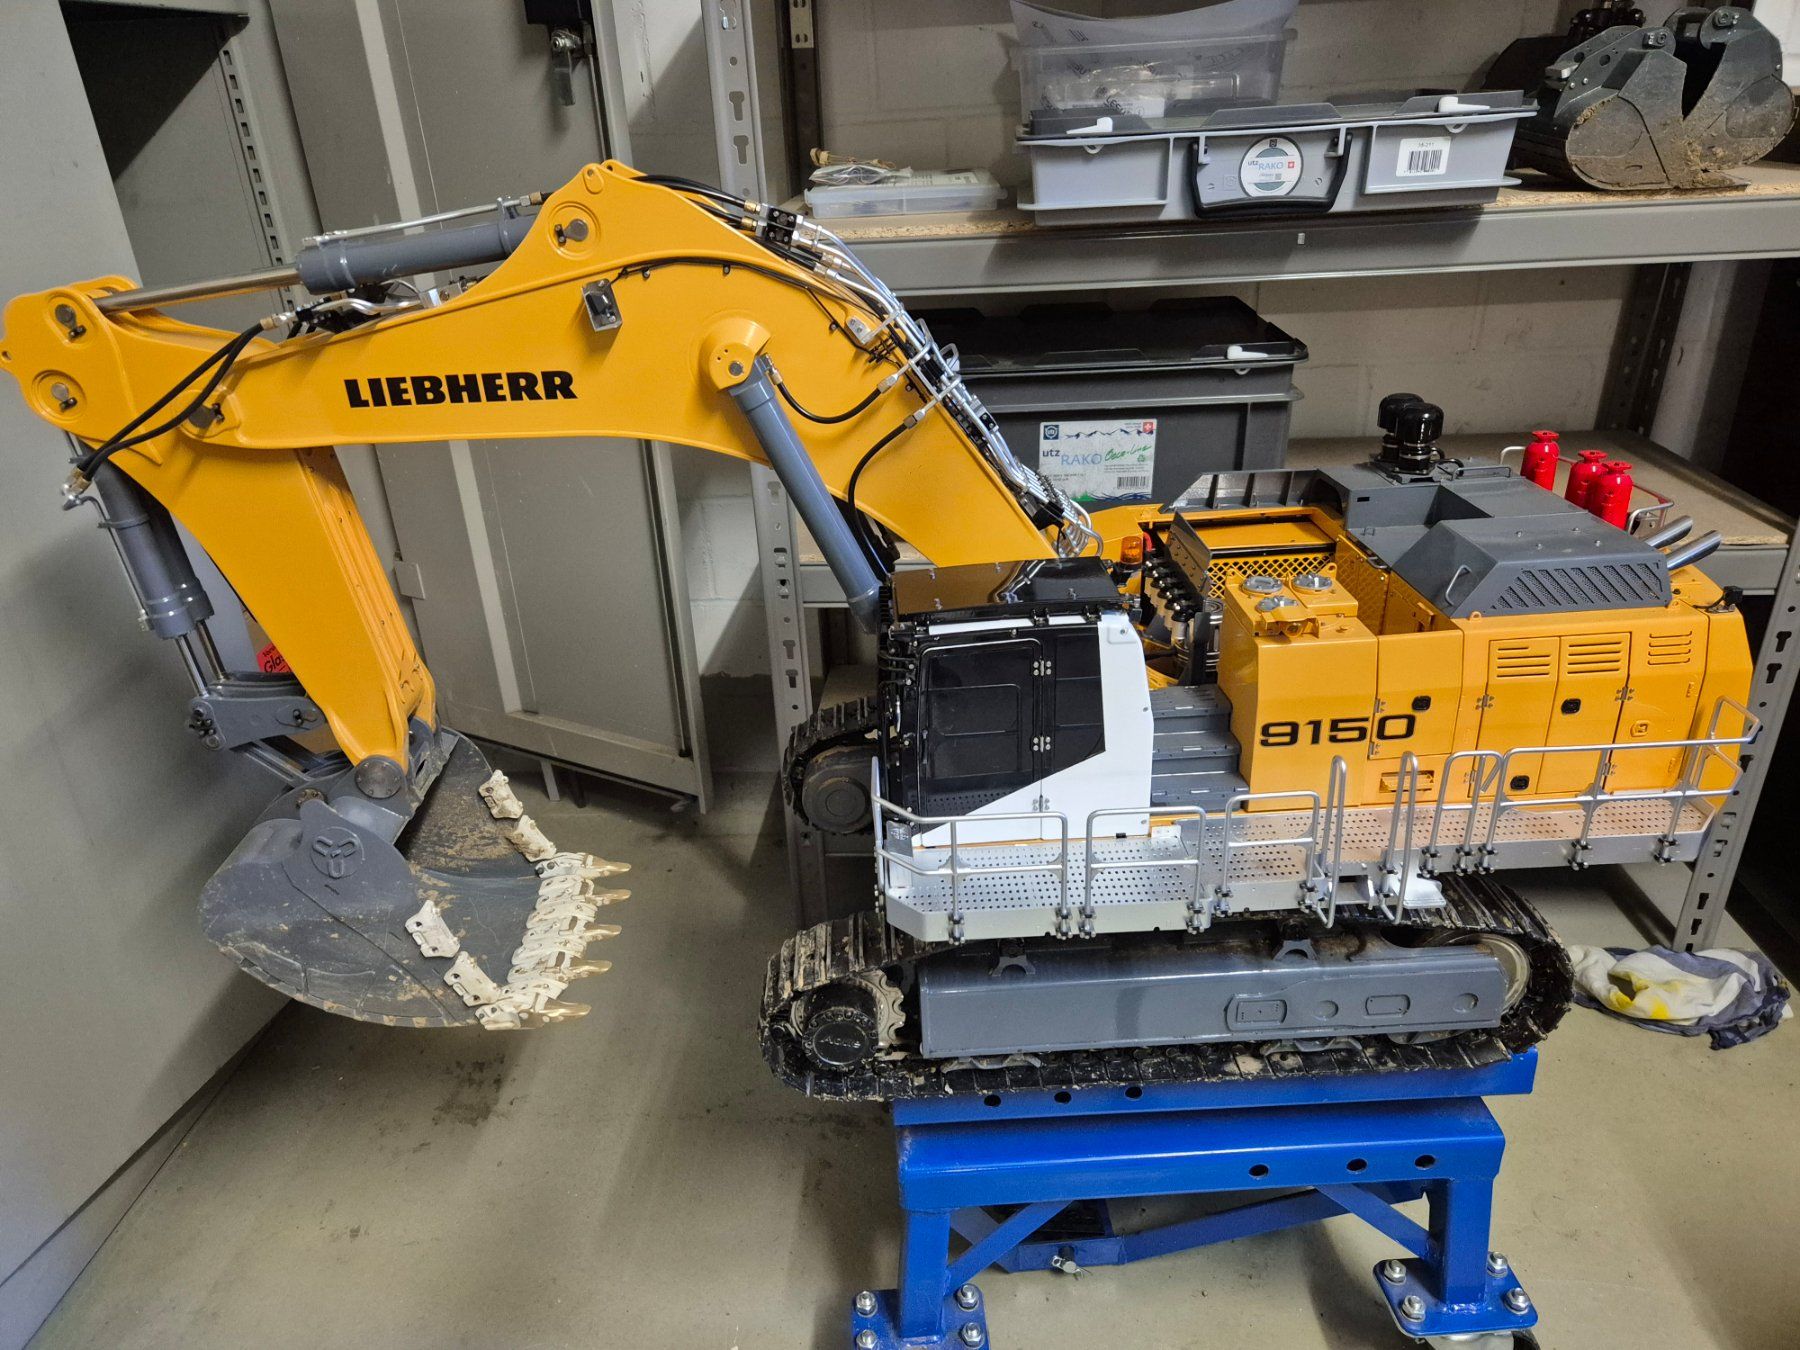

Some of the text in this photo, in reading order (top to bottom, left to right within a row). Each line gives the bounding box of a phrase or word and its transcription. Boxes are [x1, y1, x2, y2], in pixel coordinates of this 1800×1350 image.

[1258, 162, 1284, 170] RAKO
[344, 371, 578, 408] LIEBHERR
[1043, 449, 1060, 457] utz
[1061, 454, 1102, 466] RAKO
[1260, 714, 1415, 747] 9150
